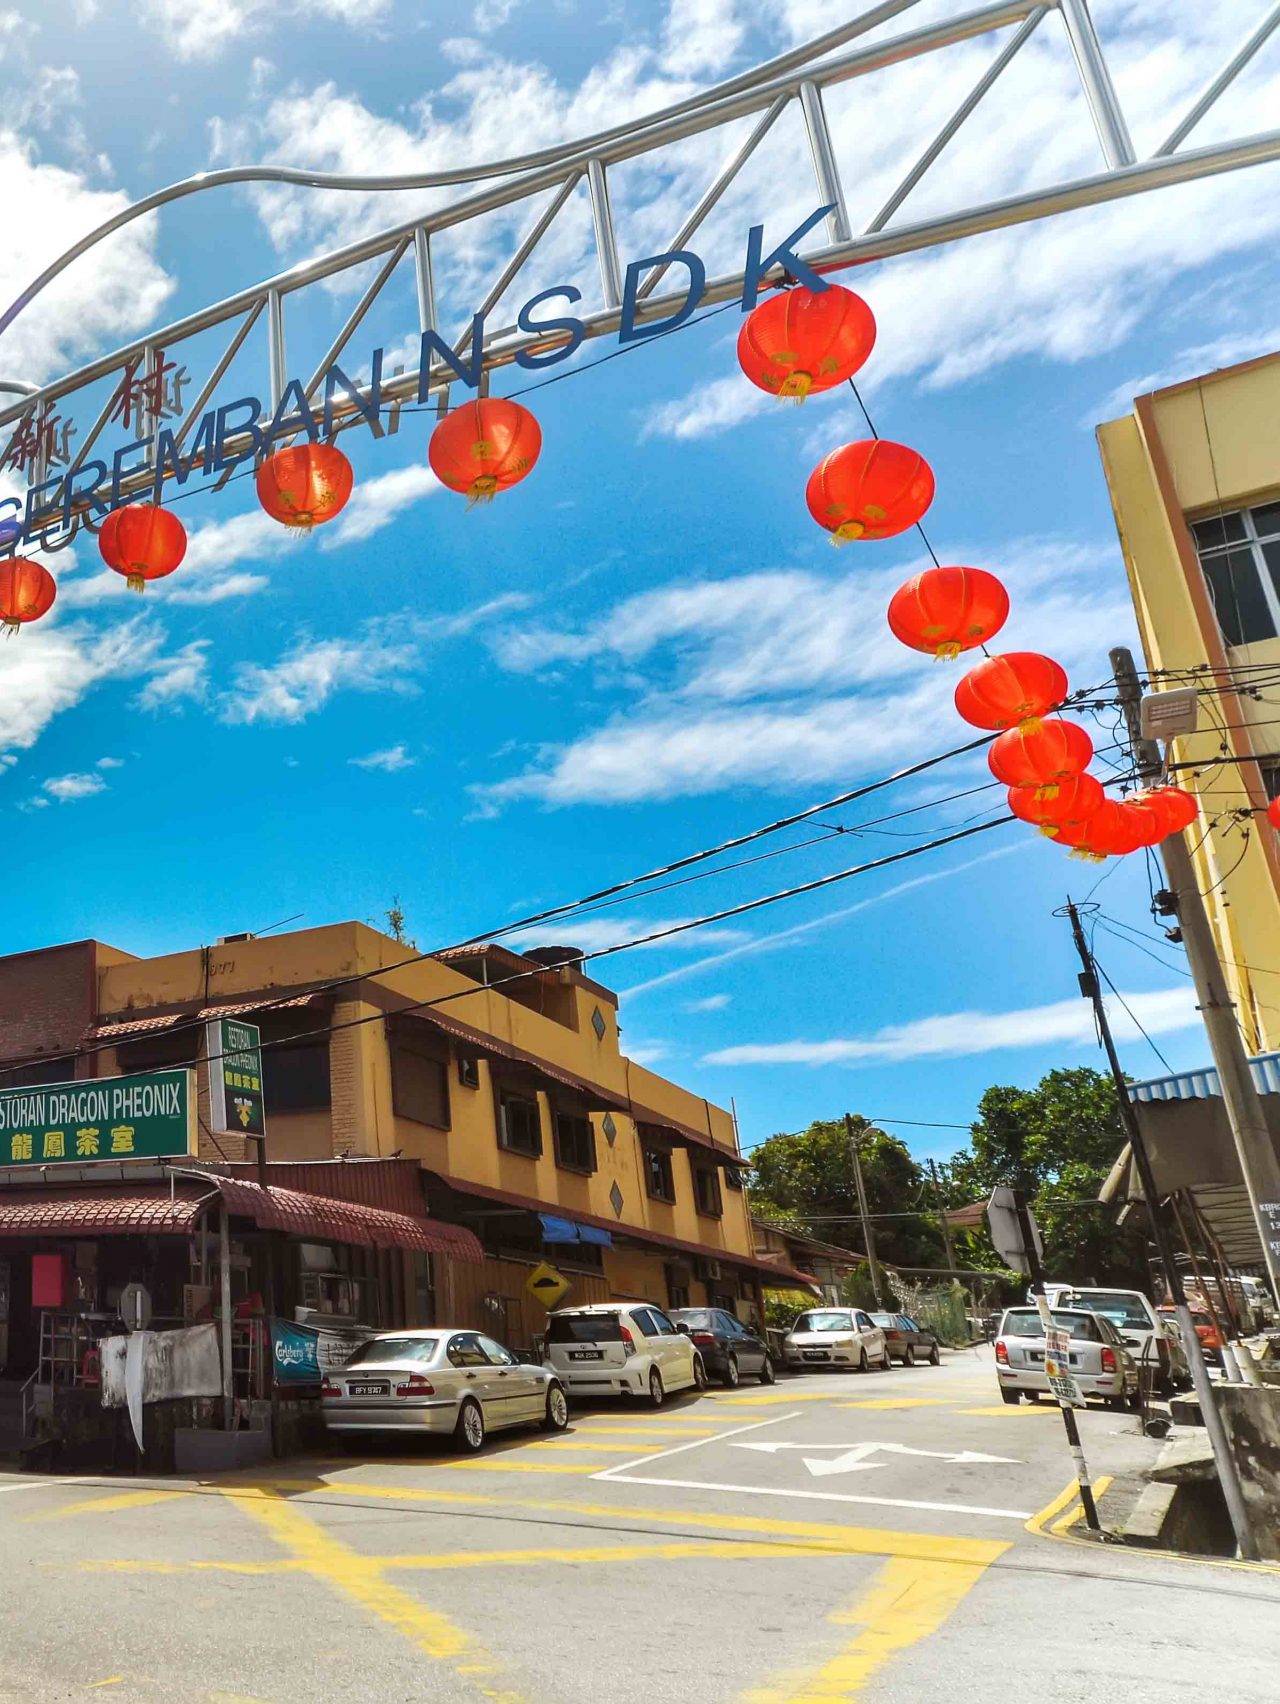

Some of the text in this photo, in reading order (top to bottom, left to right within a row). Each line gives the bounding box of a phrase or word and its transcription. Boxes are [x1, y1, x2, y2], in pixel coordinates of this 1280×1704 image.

[49, 1090, 109, 1126] DRAGON
[113, 1082, 181, 1119] PHEONIX
[11, 1124, 135, 1161] 龍鳳茶室
[275, 1340, 304, 1362] Carlsberg
